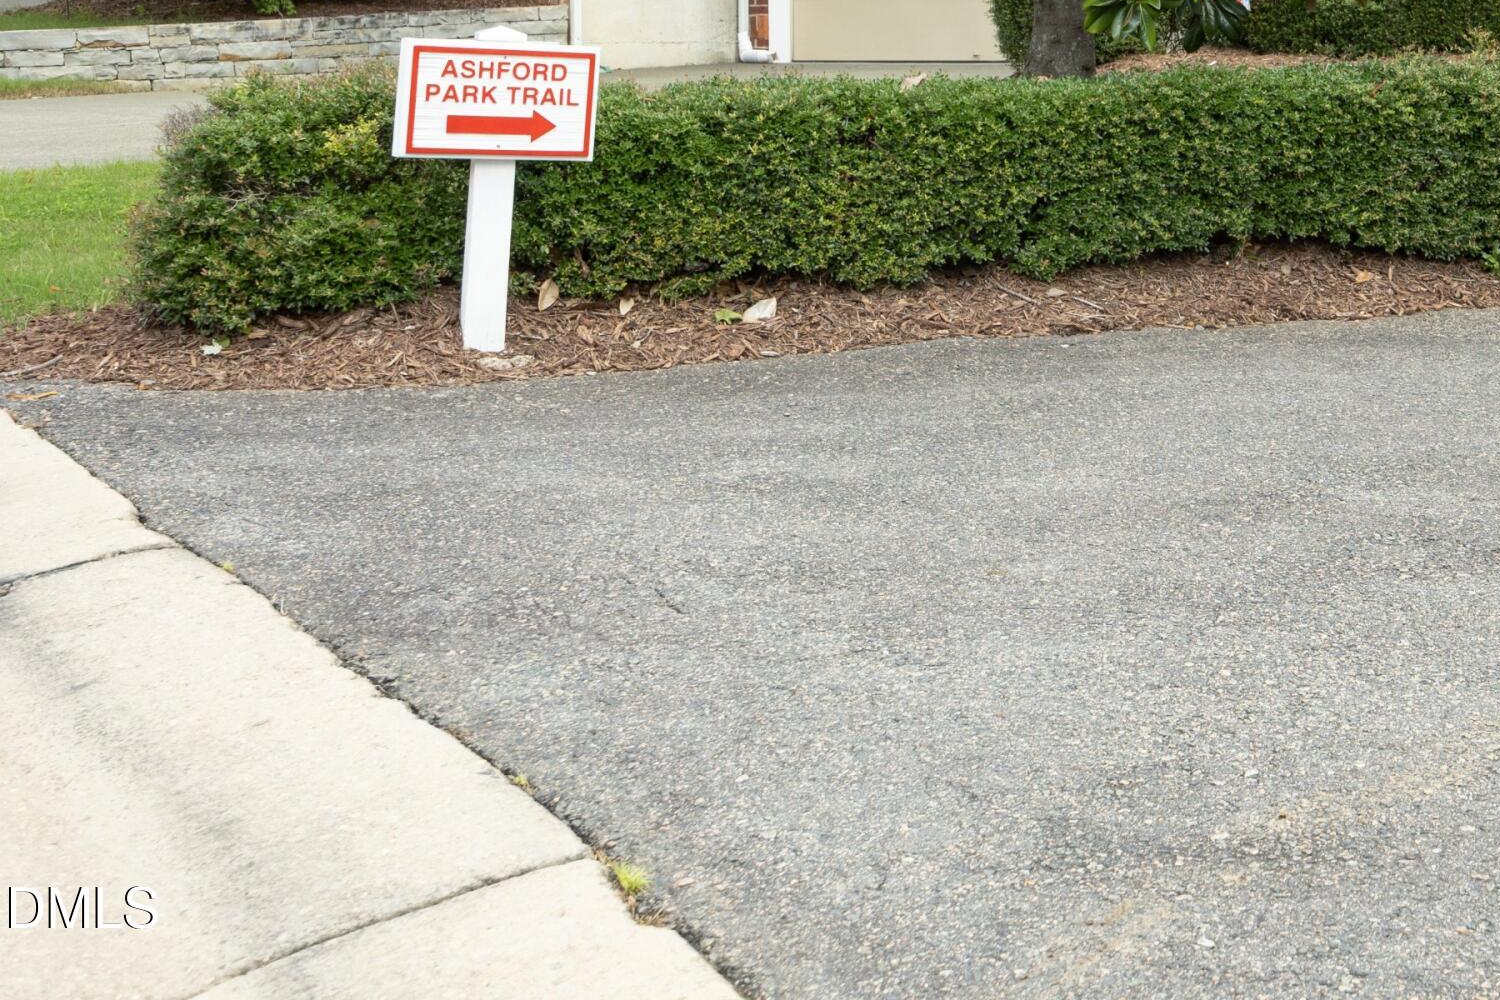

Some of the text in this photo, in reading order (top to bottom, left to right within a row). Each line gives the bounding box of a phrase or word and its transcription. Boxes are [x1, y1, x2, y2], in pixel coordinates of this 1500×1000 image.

[441, 60, 568, 82] ASHFORD
[425, 84, 580, 107] PARK TRAIL
